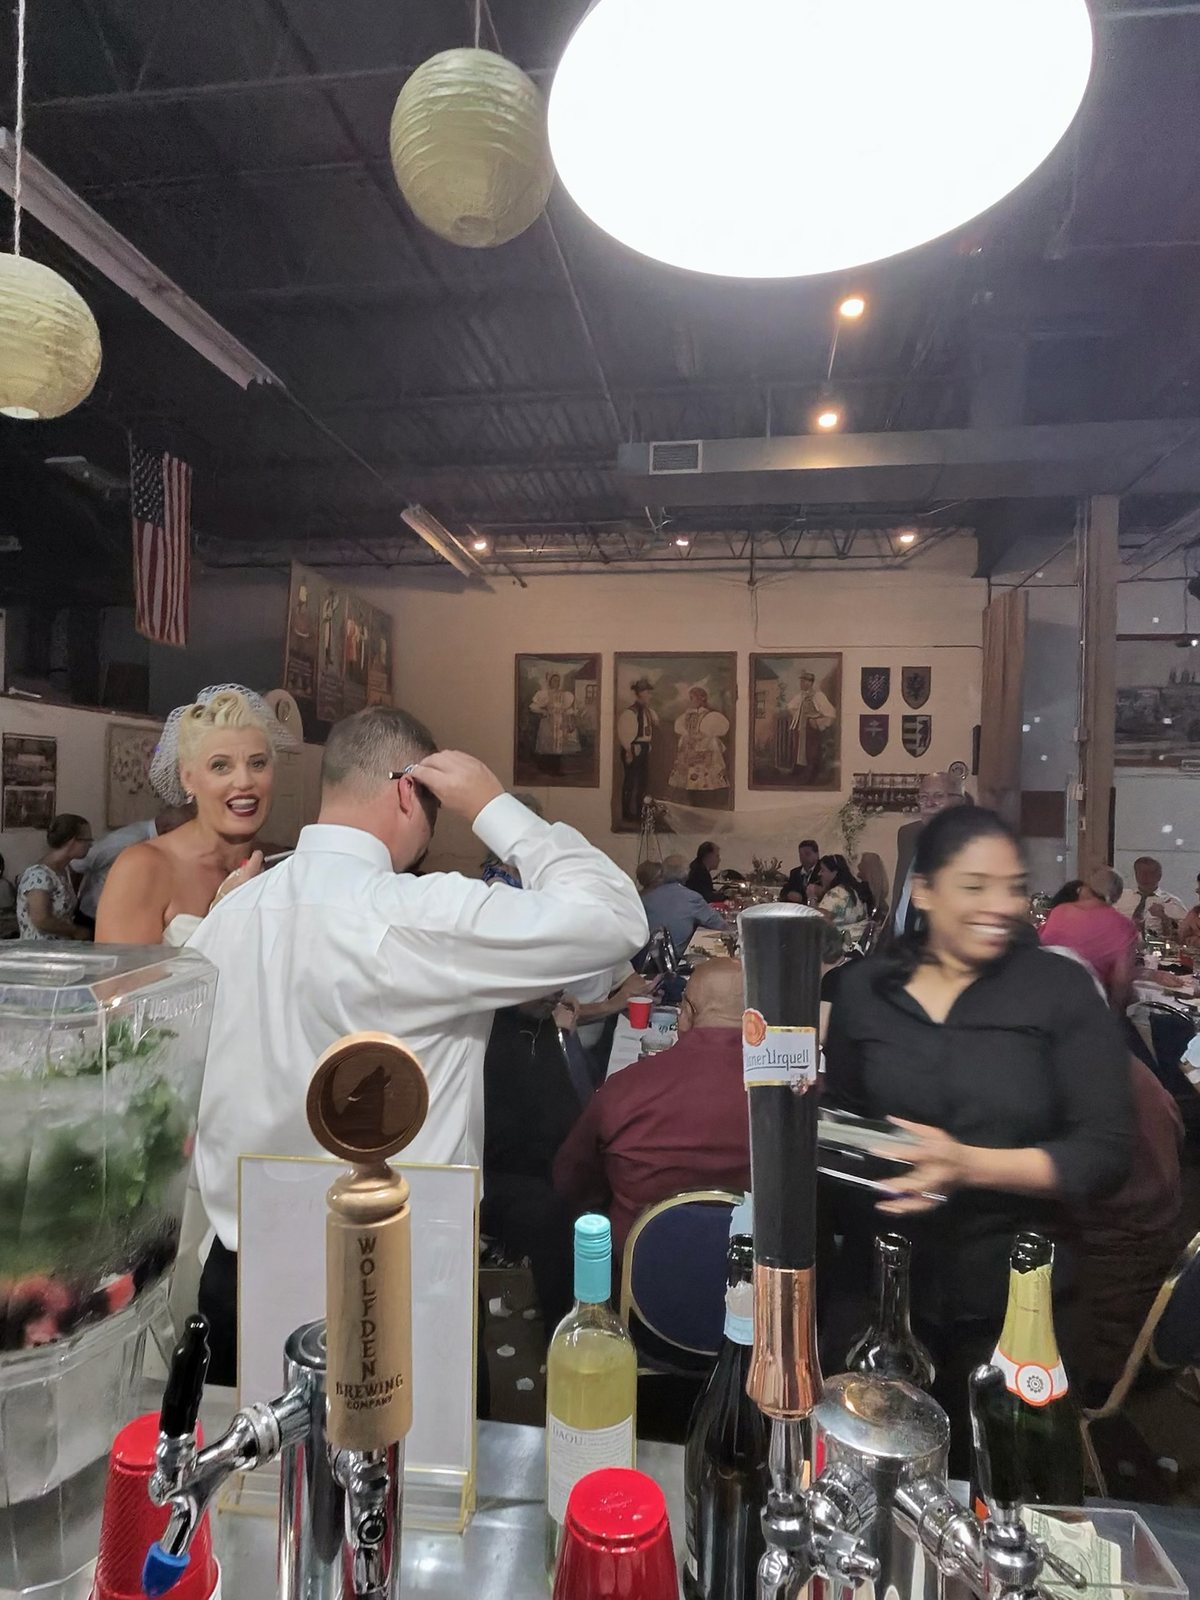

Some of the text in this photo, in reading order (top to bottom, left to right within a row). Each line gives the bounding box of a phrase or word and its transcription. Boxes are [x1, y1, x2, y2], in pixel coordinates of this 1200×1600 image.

[766, 1048, 809, 1072] Urquell
[336, 1374, 404, 1400] BREWING
[346, 1395, 394, 1410] COMPANY
